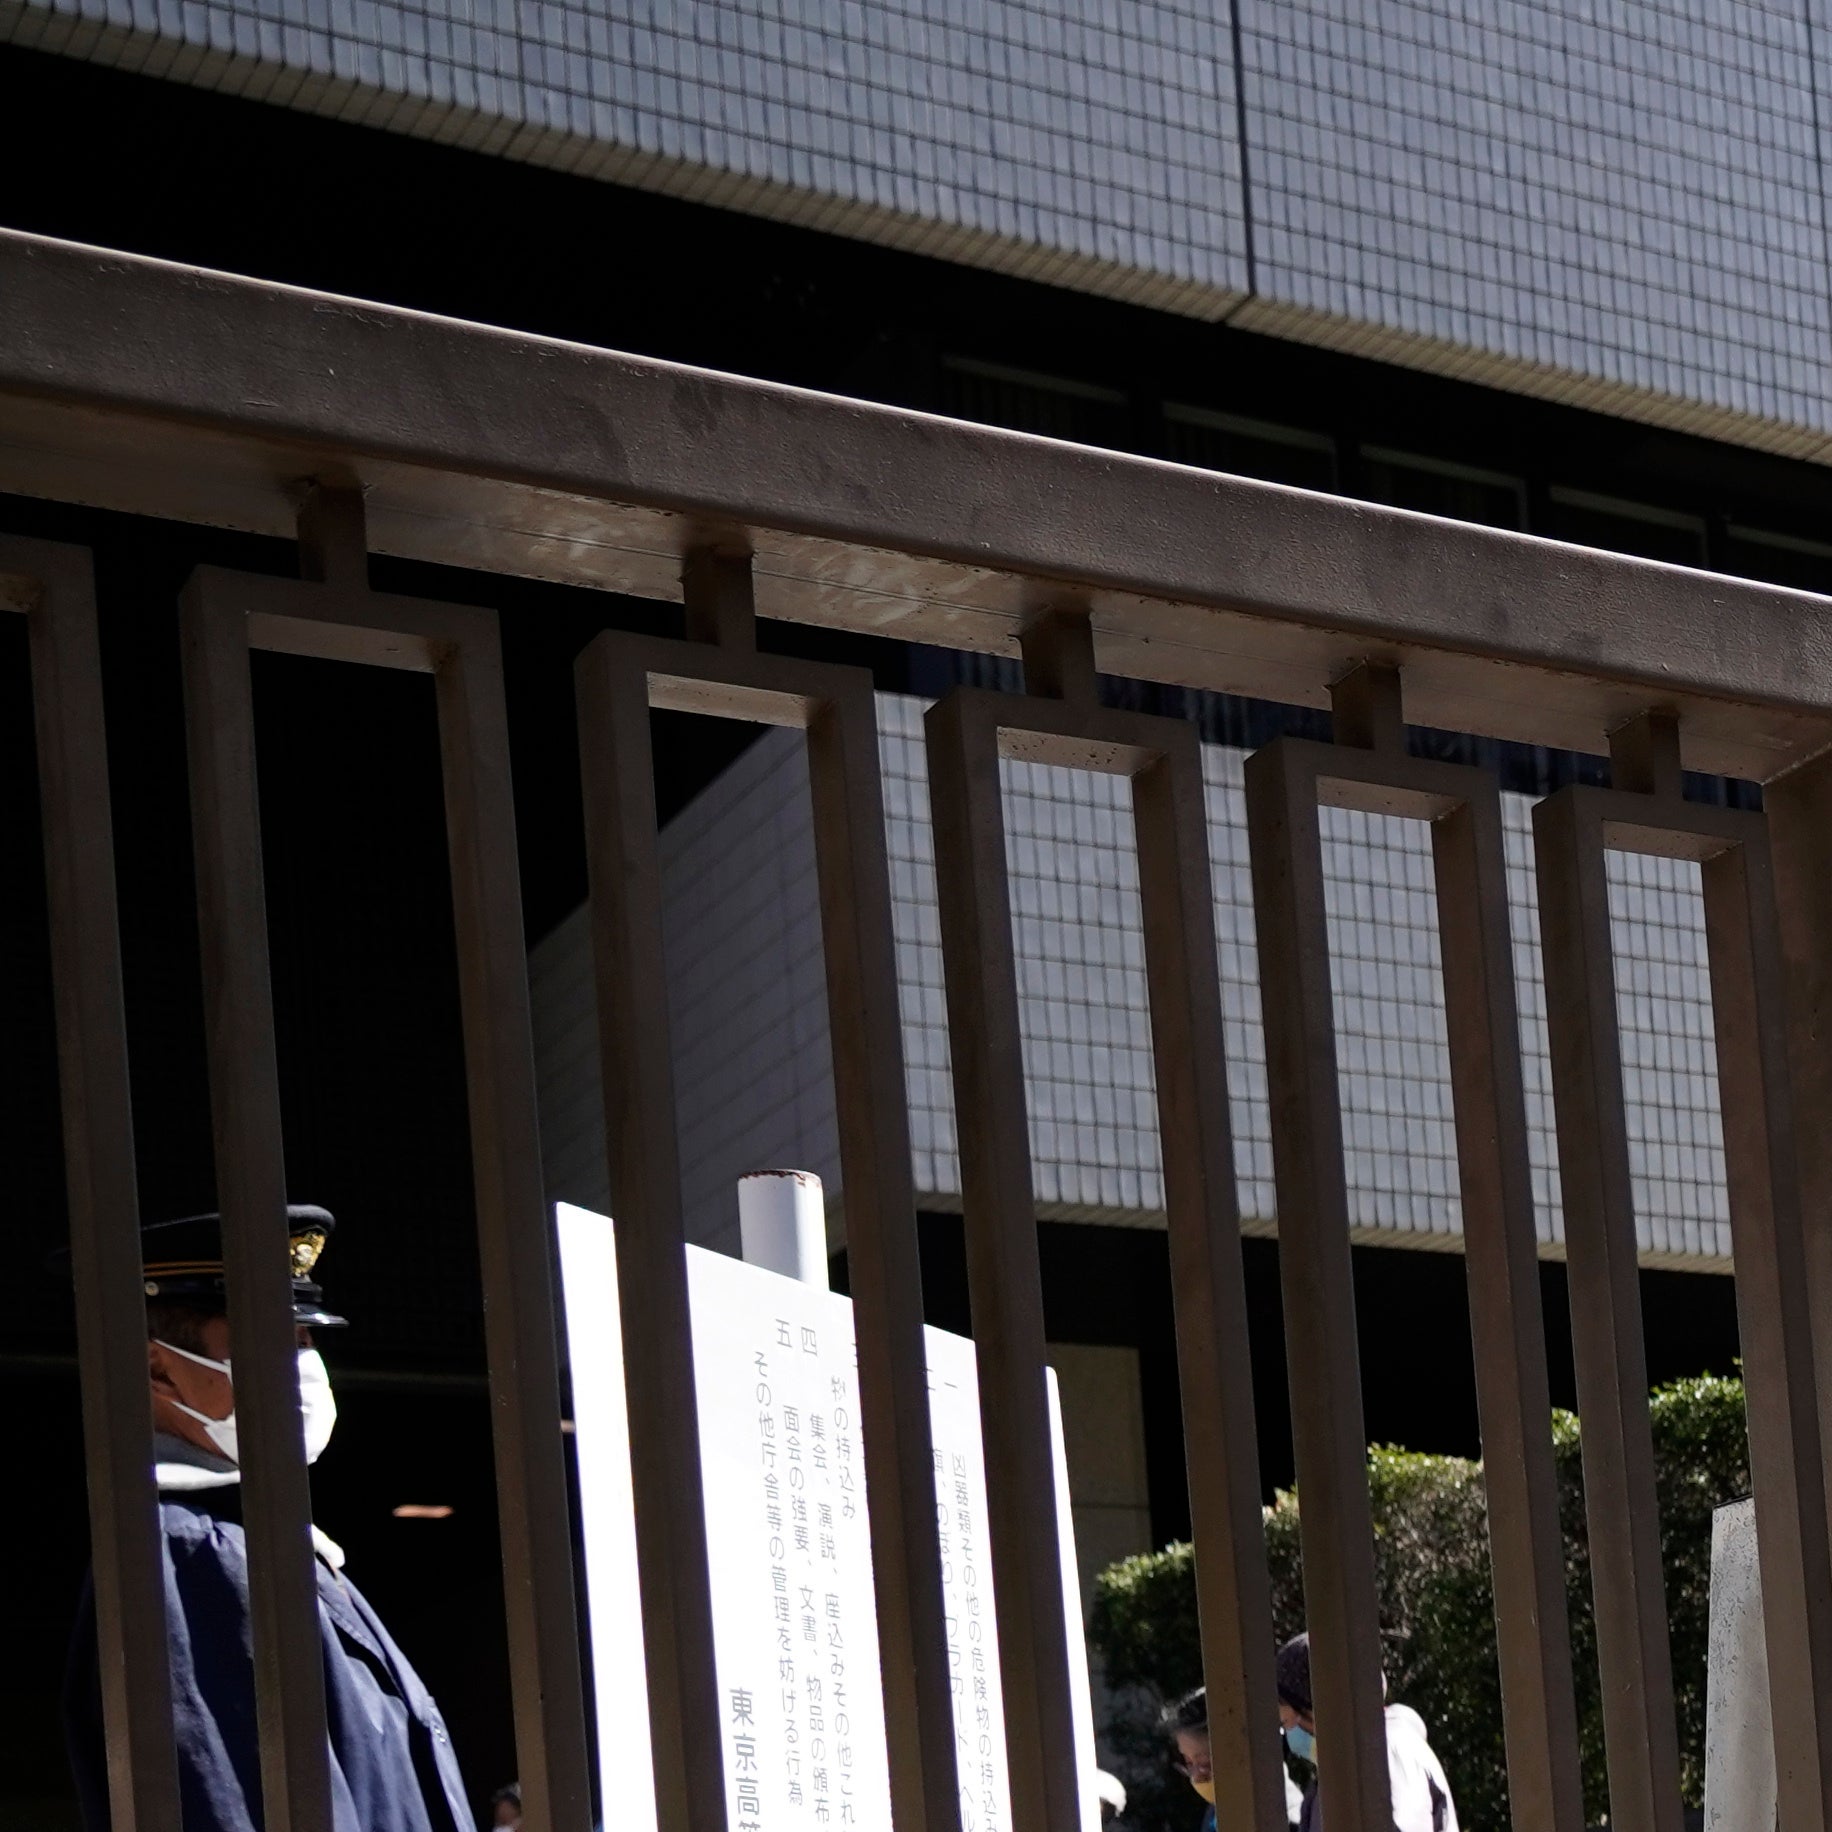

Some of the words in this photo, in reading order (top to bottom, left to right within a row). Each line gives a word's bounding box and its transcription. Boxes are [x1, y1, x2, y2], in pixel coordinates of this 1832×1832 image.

[775, 1318, 793, 1350] 五
[800, 1325, 818, 1357] 四
[753, 1350, 803, 1807] その他庁舎等の管理を妨げる行為
